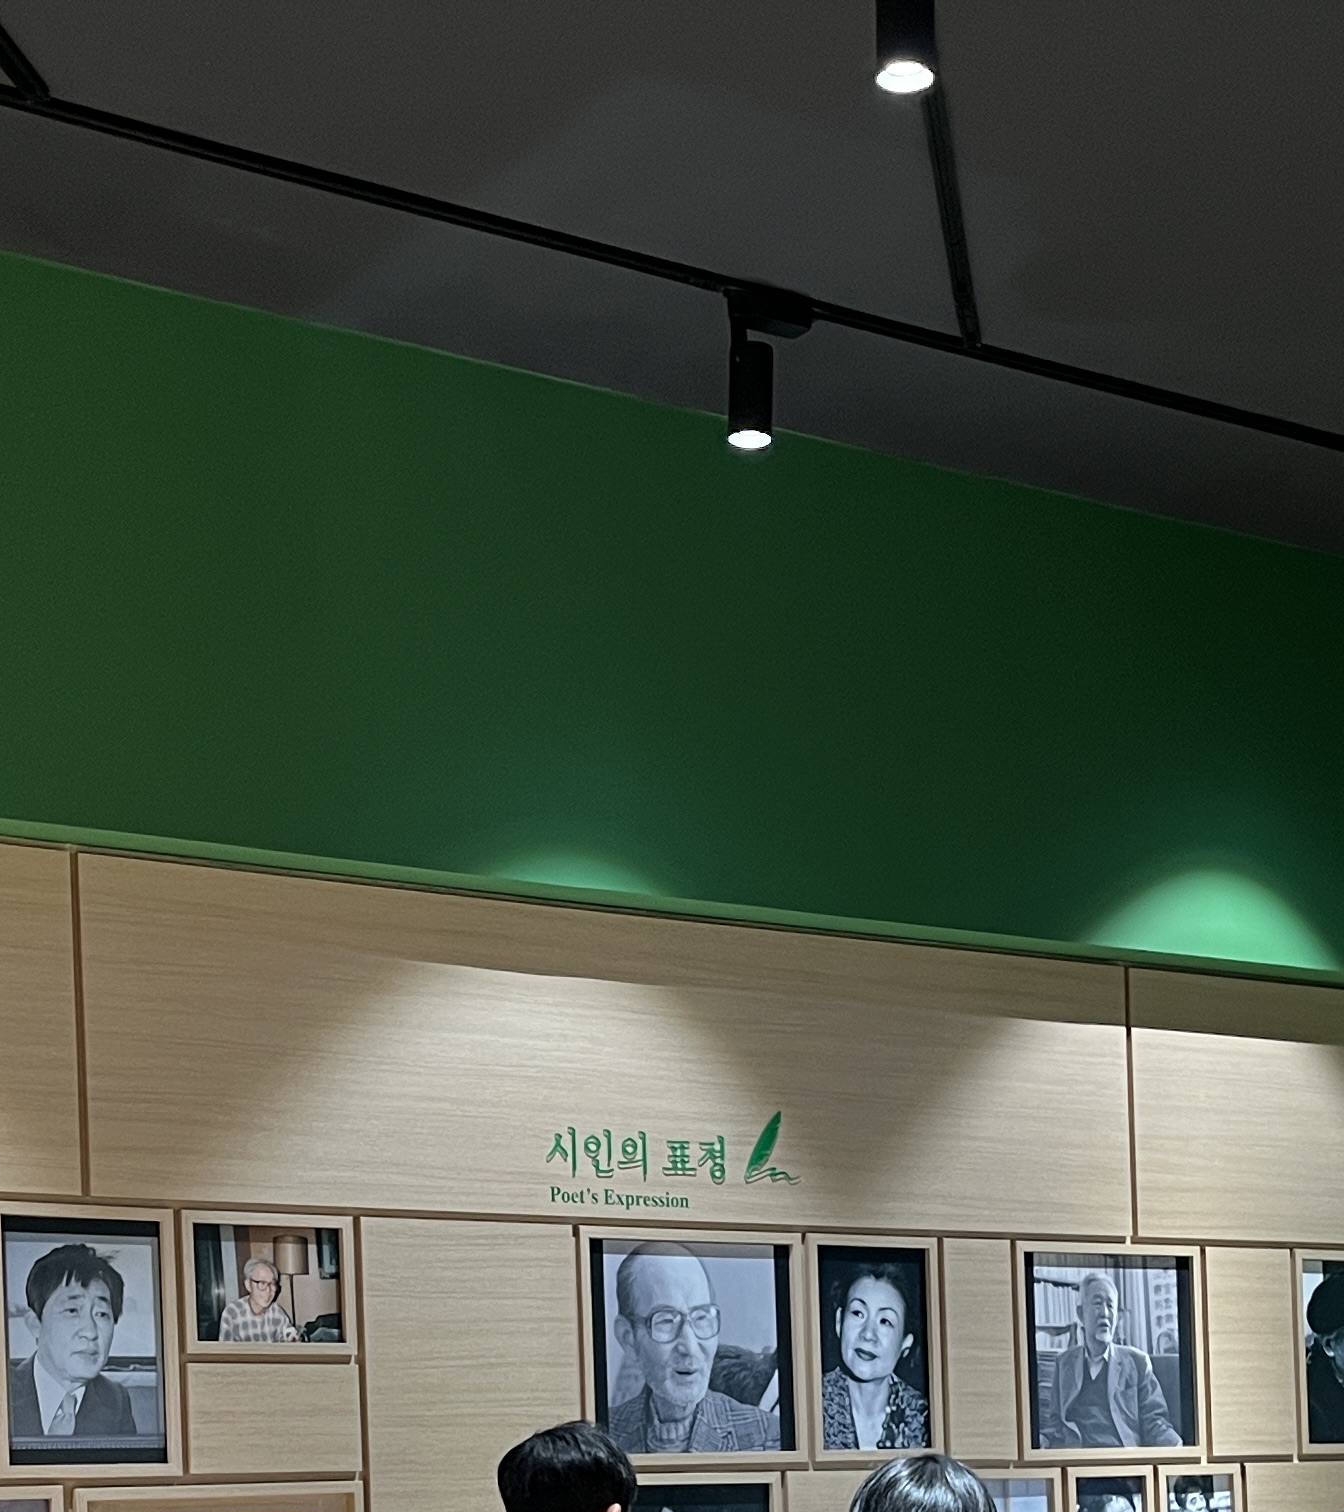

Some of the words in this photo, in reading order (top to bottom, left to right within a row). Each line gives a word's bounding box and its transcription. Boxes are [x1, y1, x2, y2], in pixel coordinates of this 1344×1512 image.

[546, 1126, 648, 1182] 시인의
[662, 1135, 726, 1185] 표정
[550, 1186, 599, 1204] Poet's
[604, 1188, 689, 1210] Expression
